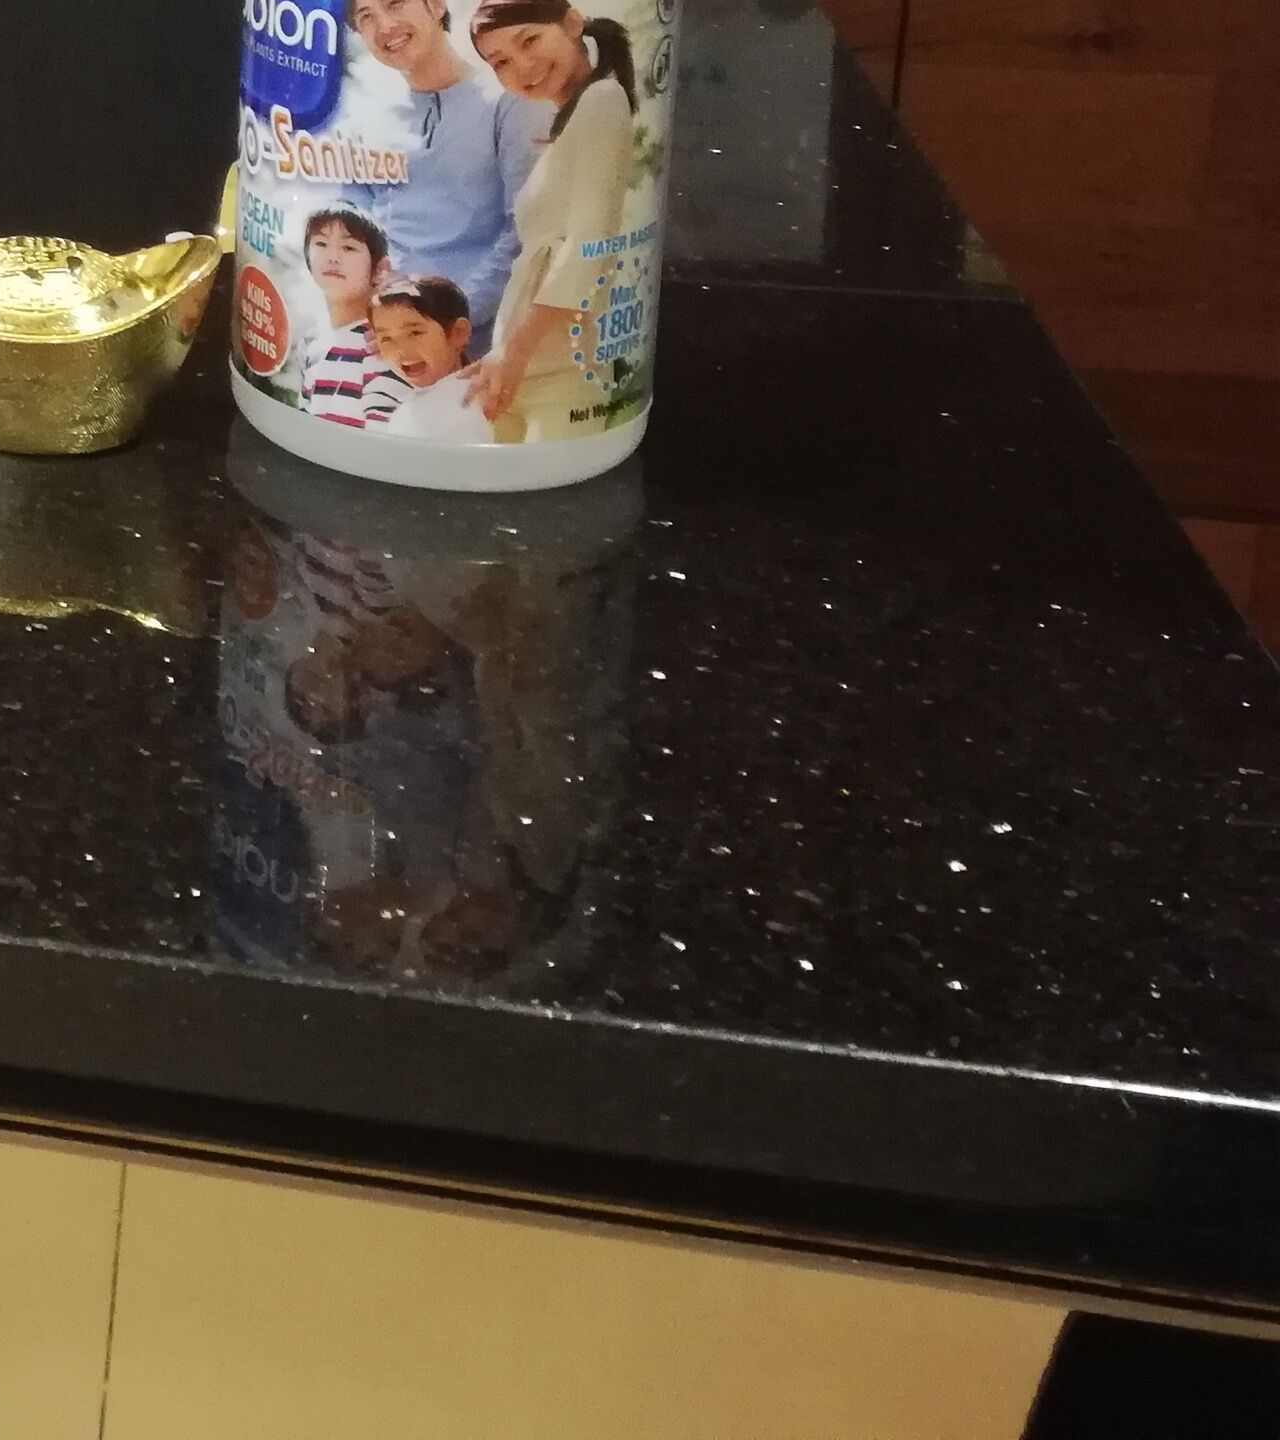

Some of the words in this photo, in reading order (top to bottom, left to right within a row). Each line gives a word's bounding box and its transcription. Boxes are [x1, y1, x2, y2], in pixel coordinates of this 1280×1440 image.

[277, 50, 328, 78] EXTRACT
[581, 235, 627, 259] WATER
[246, 280, 272, 313] Kills
[596, 300, 644, 342] 1800
